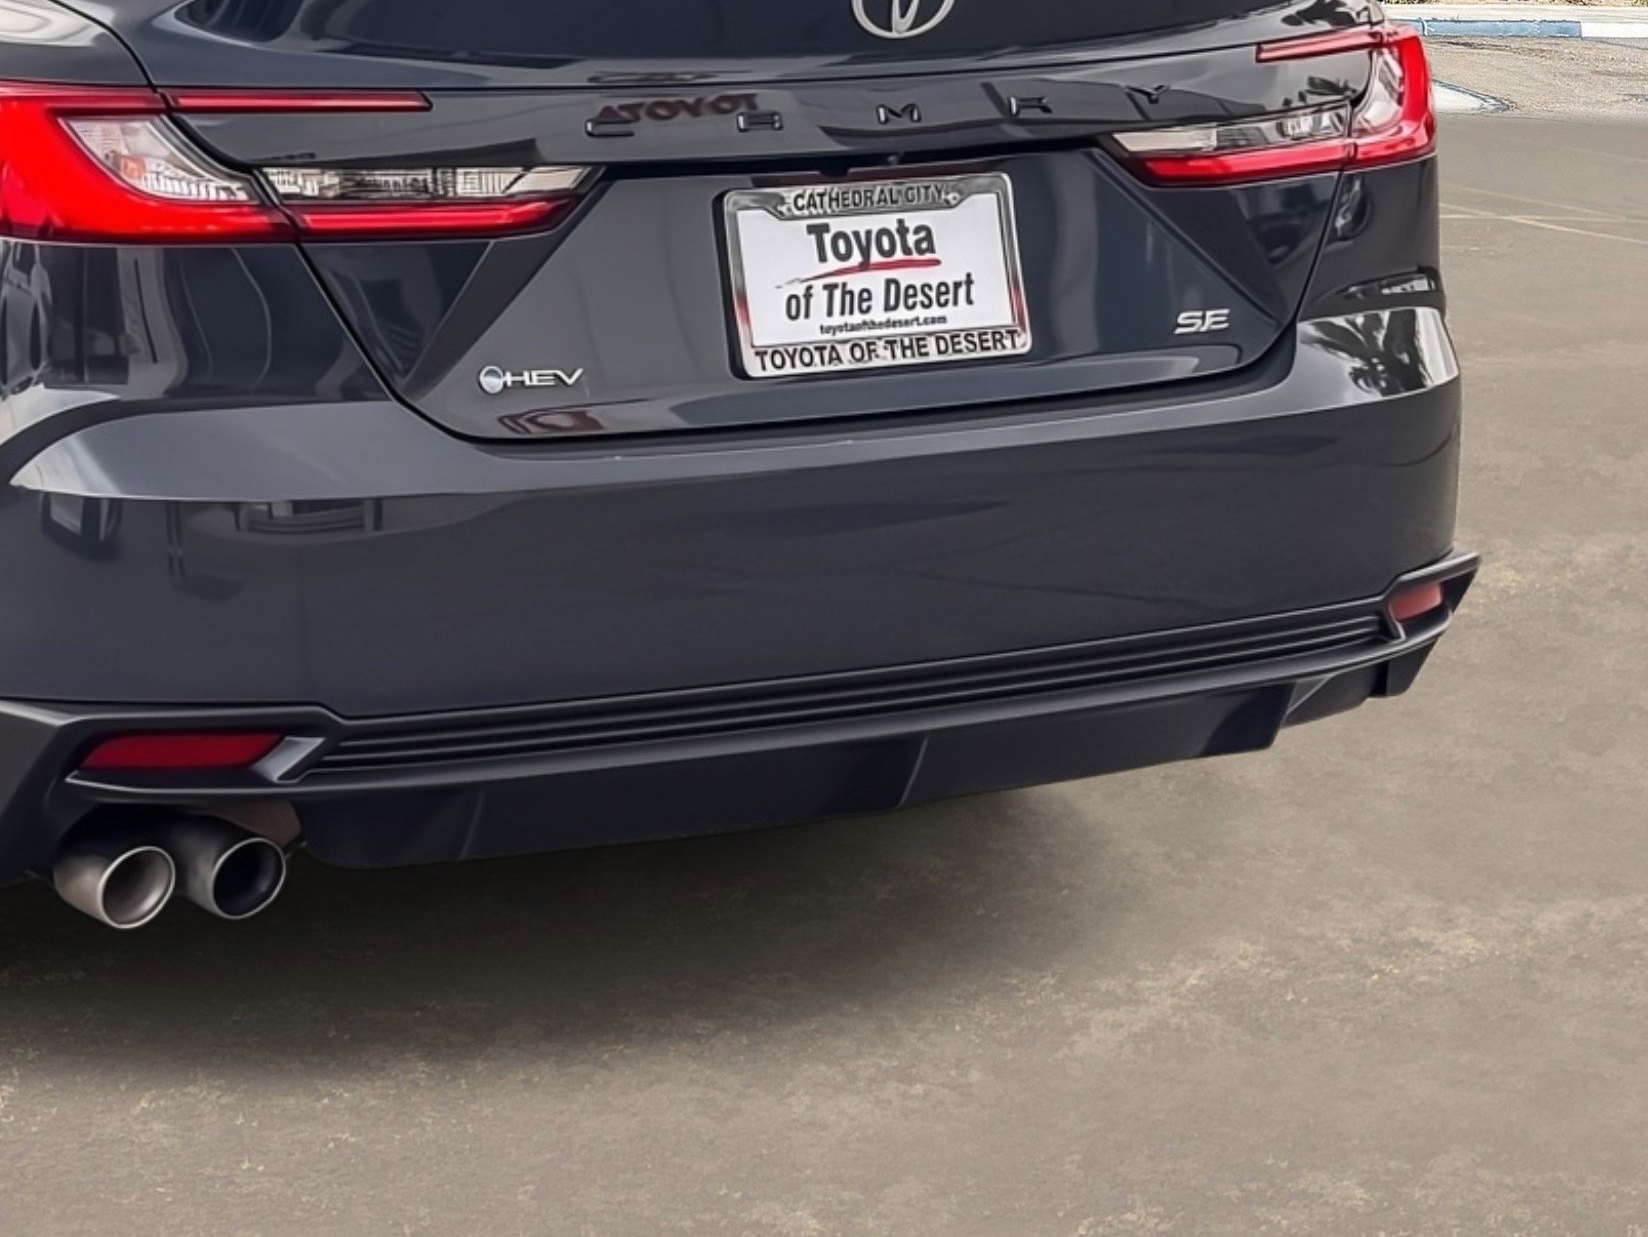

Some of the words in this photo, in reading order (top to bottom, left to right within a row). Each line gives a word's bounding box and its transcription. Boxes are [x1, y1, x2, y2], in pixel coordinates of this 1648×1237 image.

[792, 188, 899, 212] CATHEDRAL
[905, 184, 945, 204] CITY
[806, 218, 937, 268] Toyota
[785, 284, 814, 321] of
[822, 281, 873, 318] The
[883, 272, 975, 311] Desert
[1173, 308, 1231, 334] SE
[755, 346, 842, 372] TOYOTA
[851, 340, 878, 363] OF
[886, 336, 930, 361] THE
[935, 329, 1022, 355] DESERT
